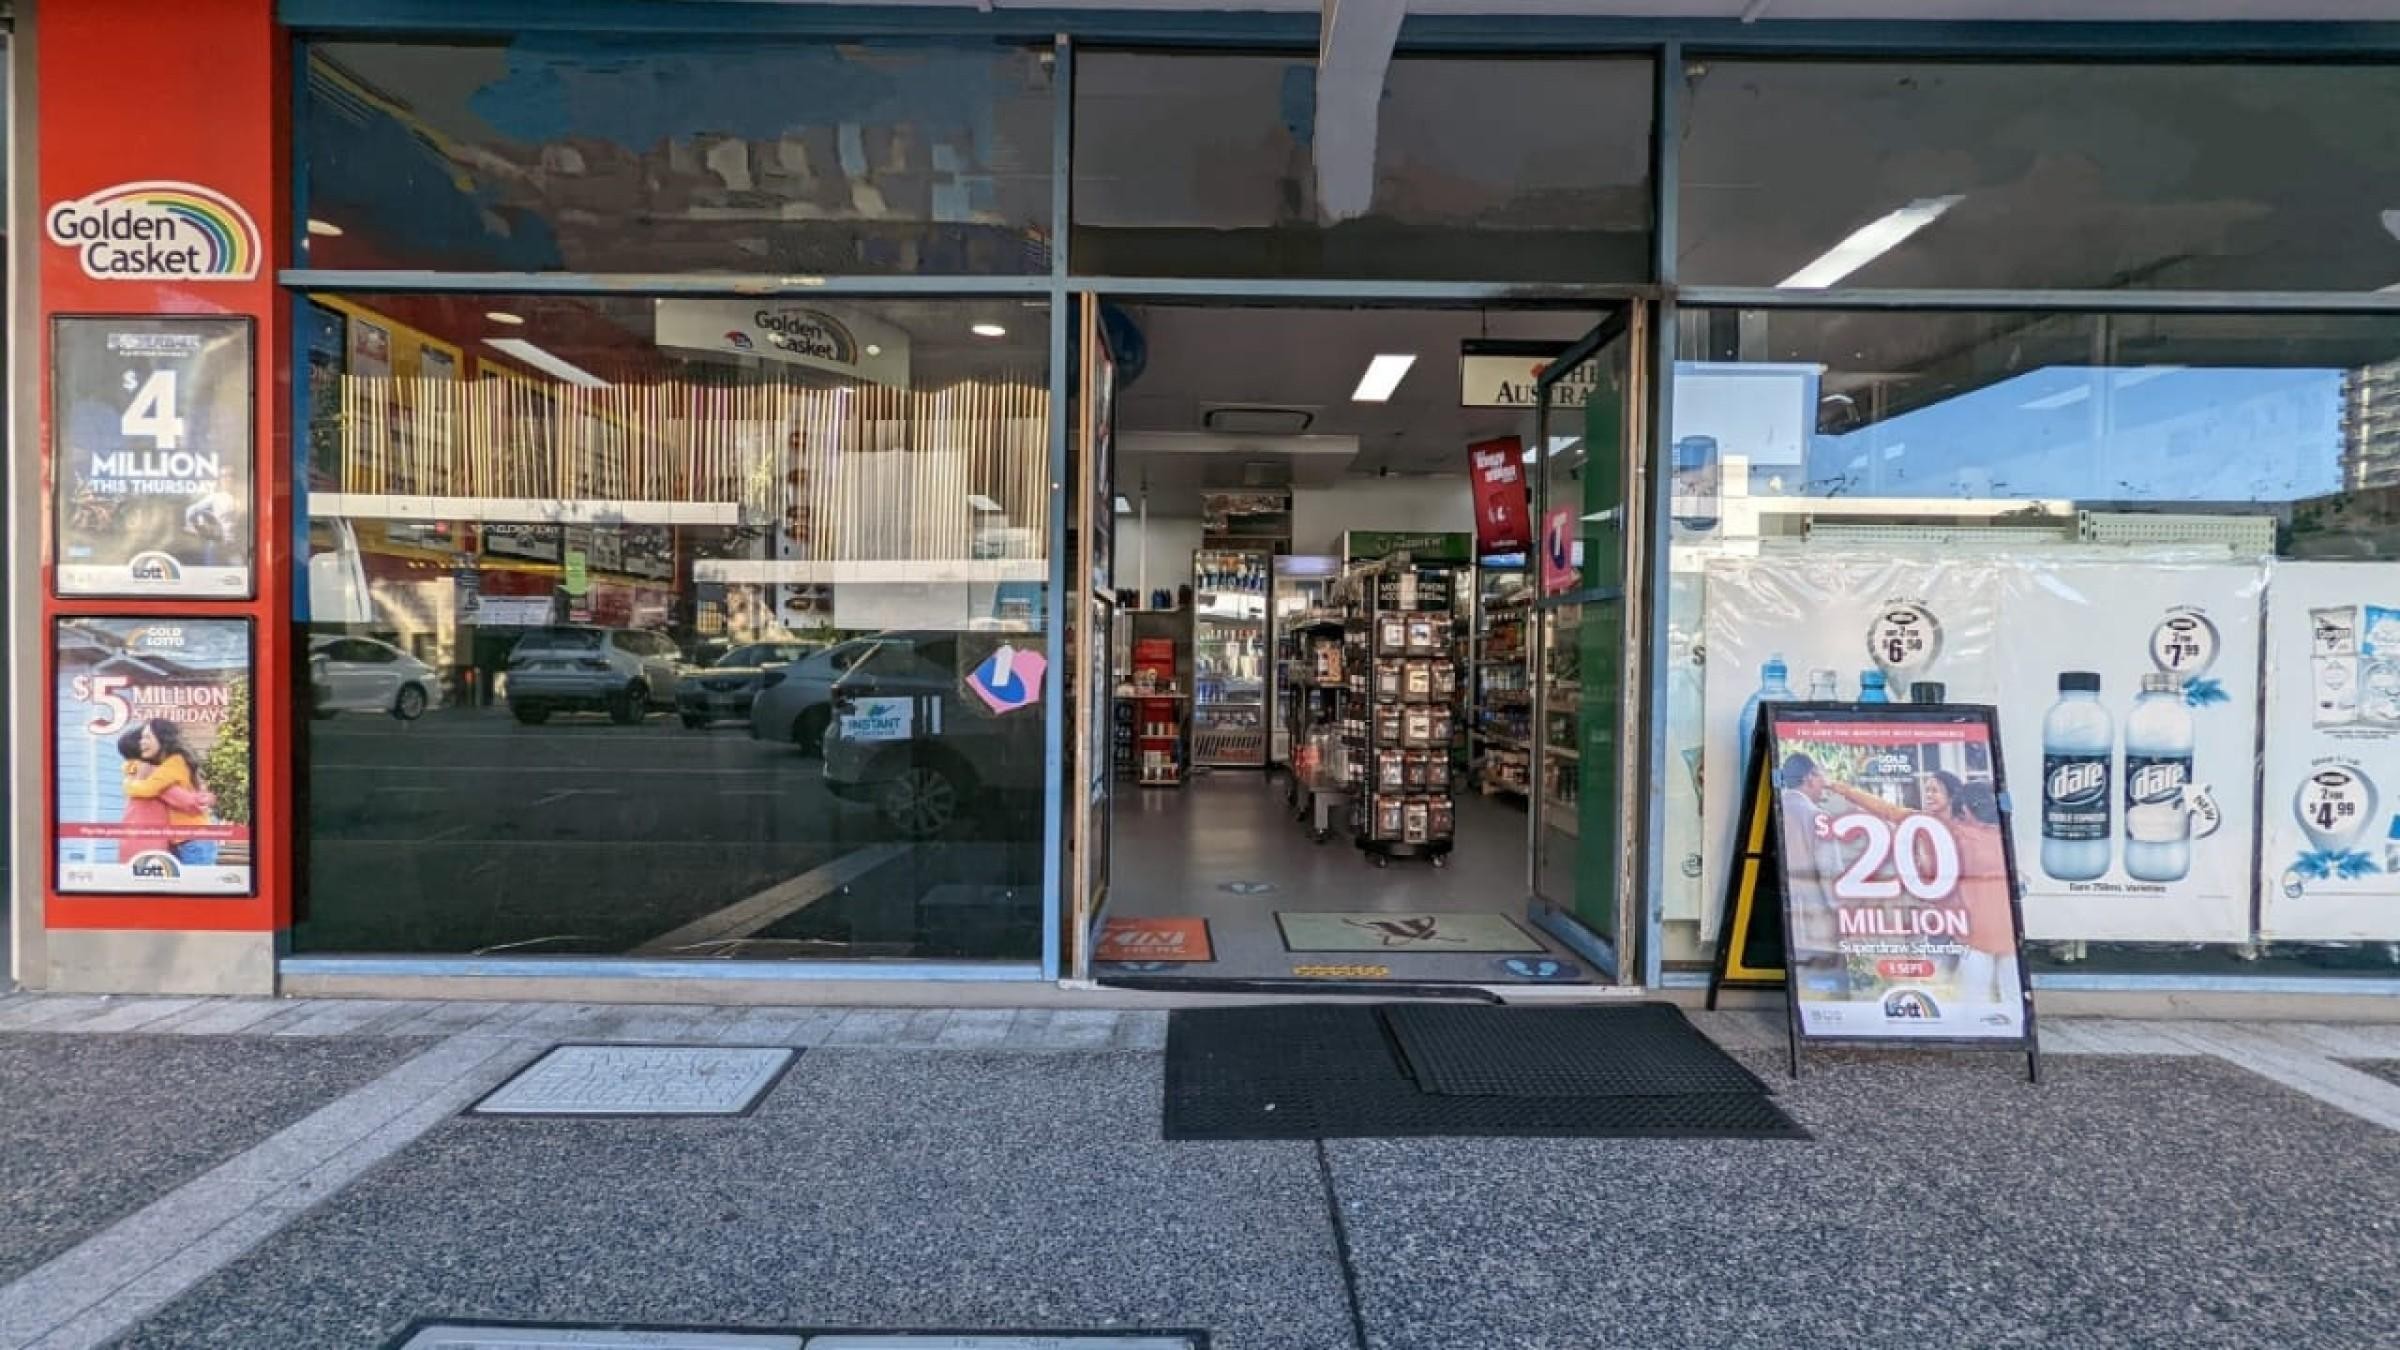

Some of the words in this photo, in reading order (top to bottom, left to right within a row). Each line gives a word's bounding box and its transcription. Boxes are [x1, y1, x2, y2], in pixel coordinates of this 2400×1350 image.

[53, 208, 176, 241] Golden
[87, 242, 201, 274] Casket
[755, 310, 822, 338] Golden
[121, 369, 185, 450] $4
[91, 451, 219, 478] MILLION
[91, 479, 128, 494] THIS
[133, 479, 217, 494] THURSDAY
[72, 676, 131, 736] $5
[132, 686, 232, 706] MILLION
[132, 706, 229, 723] SATURDAYS
[1814, 813, 1960, 900] $20
[1837, 908, 1971, 937] MILLION
[1838, 940, 1908, 957] Superdraw
[1911, 941, 1970, 958] Saturday
